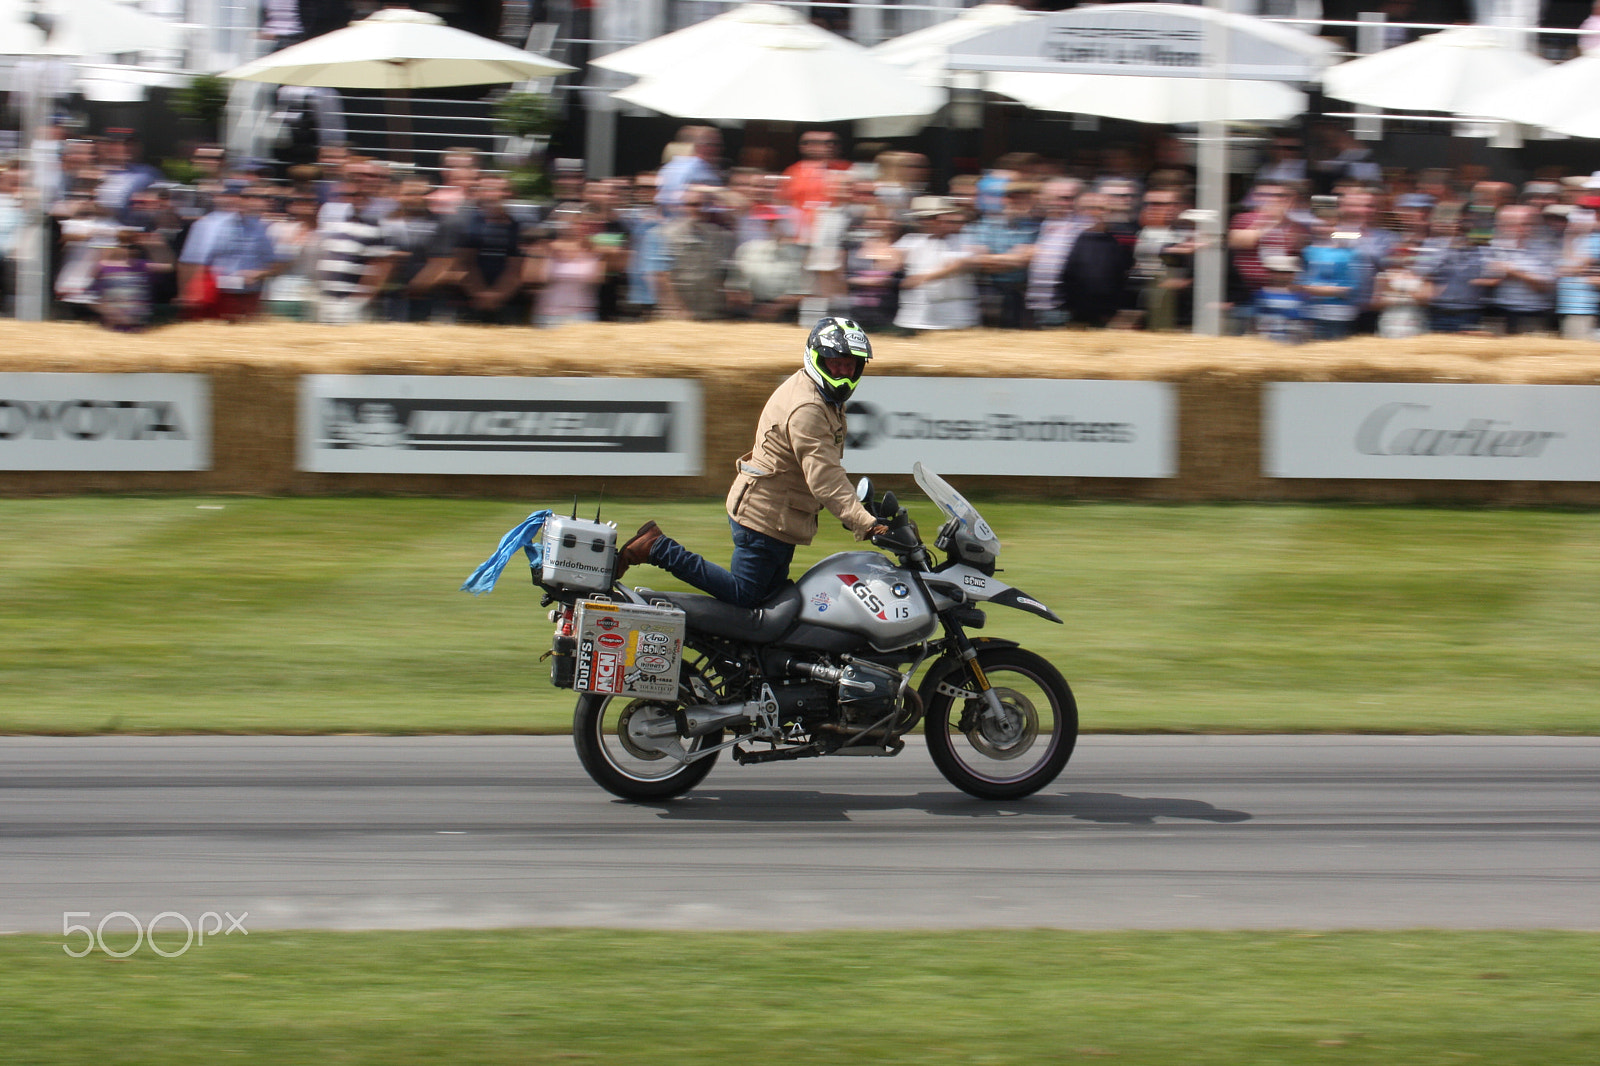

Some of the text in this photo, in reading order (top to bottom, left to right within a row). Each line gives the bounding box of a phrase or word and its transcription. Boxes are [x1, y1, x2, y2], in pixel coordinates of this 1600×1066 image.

[1354, 401, 1566, 458] Cartier
[853, 582, 885, 614] GS
[895, 607, 909, 619] 15
[598, 654, 617, 692] MCN
